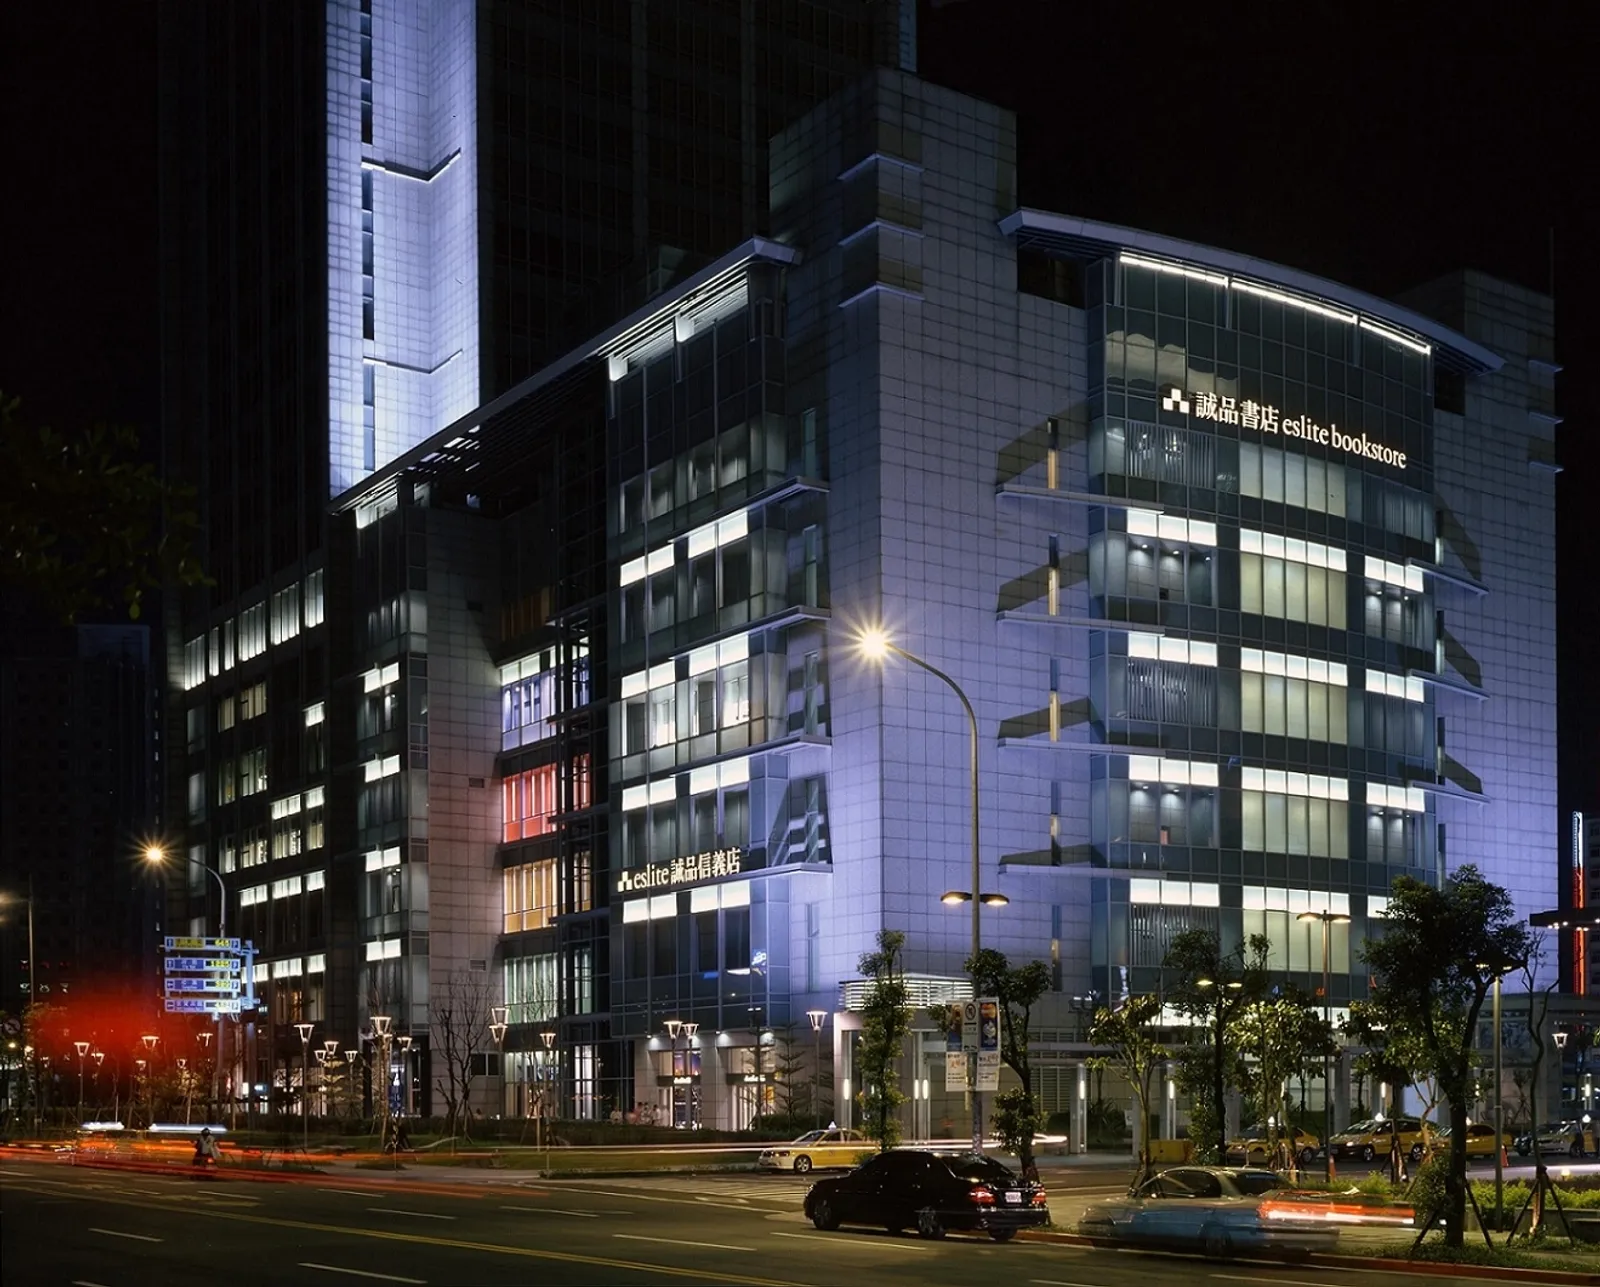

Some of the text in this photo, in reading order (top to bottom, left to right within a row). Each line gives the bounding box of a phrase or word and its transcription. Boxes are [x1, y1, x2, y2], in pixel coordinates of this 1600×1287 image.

[1195, 391, 1407, 469] 誠品書店 eslite bookstore
[633, 847, 741, 889] eslite 誠品信義店
